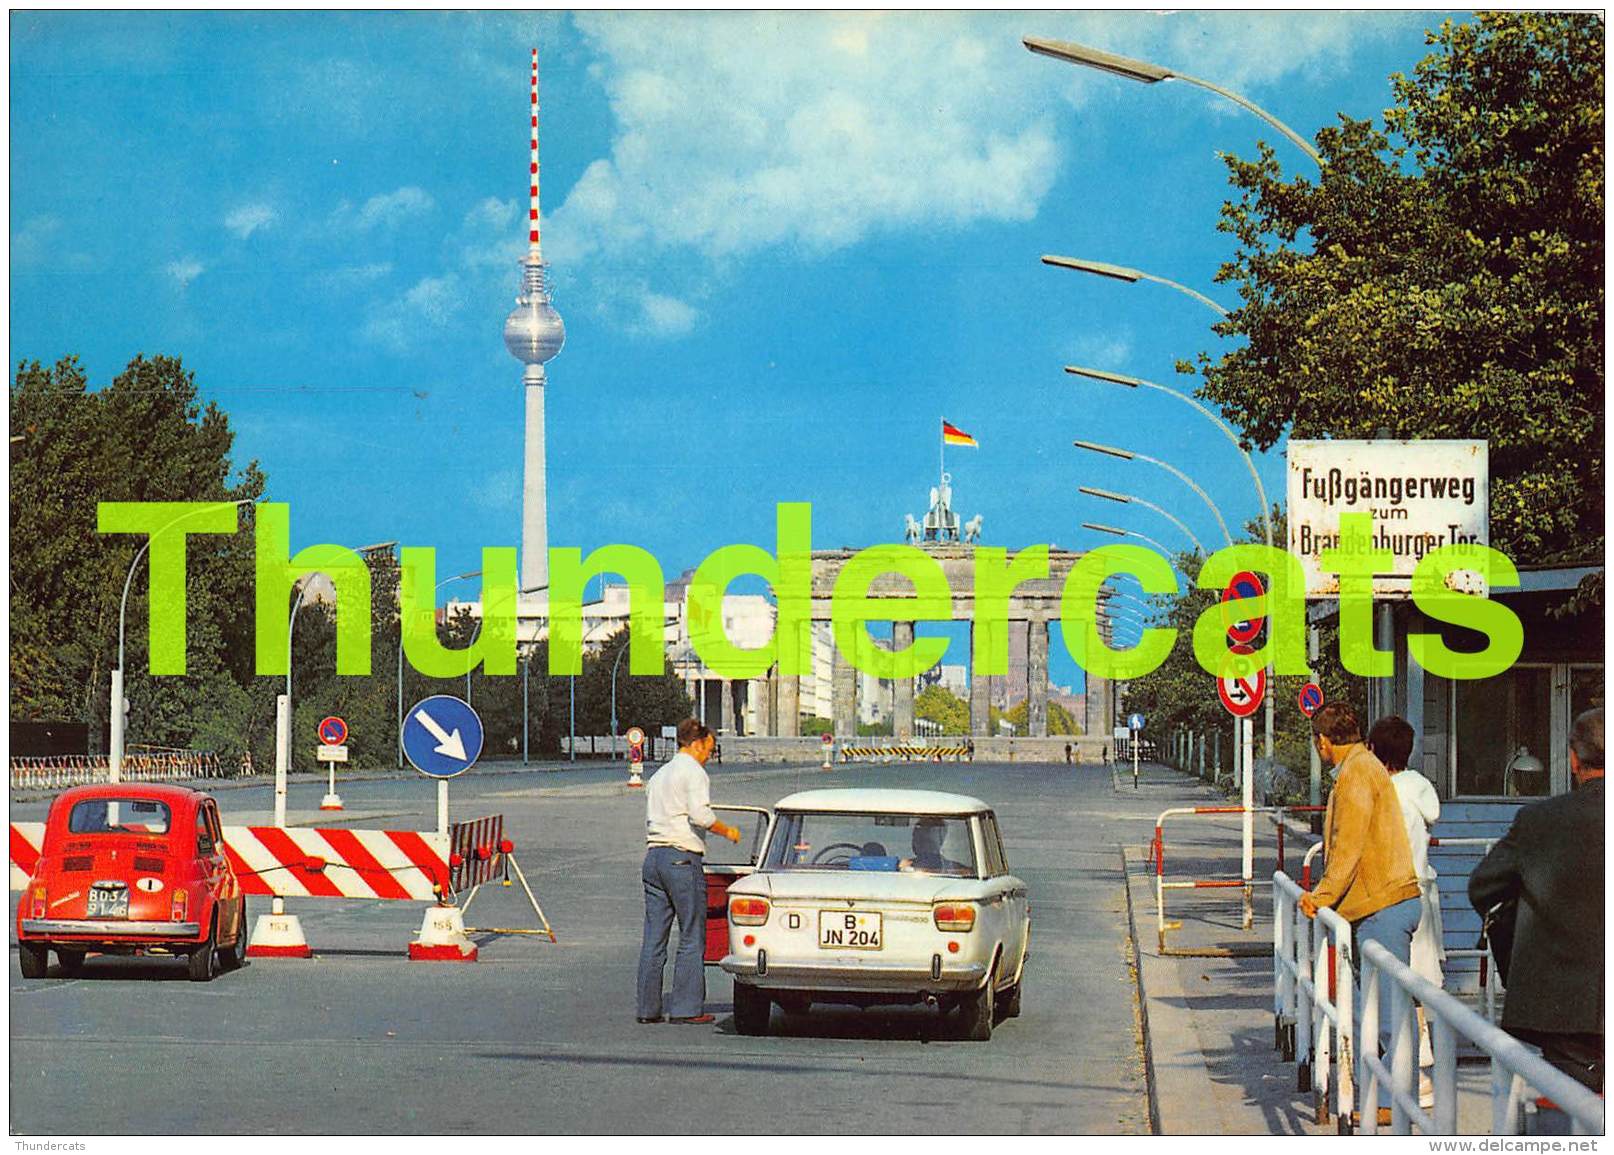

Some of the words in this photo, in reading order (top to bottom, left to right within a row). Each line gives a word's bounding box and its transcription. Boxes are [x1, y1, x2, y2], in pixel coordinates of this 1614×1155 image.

[1303, 467, 1475, 505] Fußgängerweg
[1370, 508, 1408, 519] zum
[789, 914, 800, 928] D
[845, 915, 856, 929] B
[822, 930, 843, 944] JN
[848, 930, 878, 946] 204
